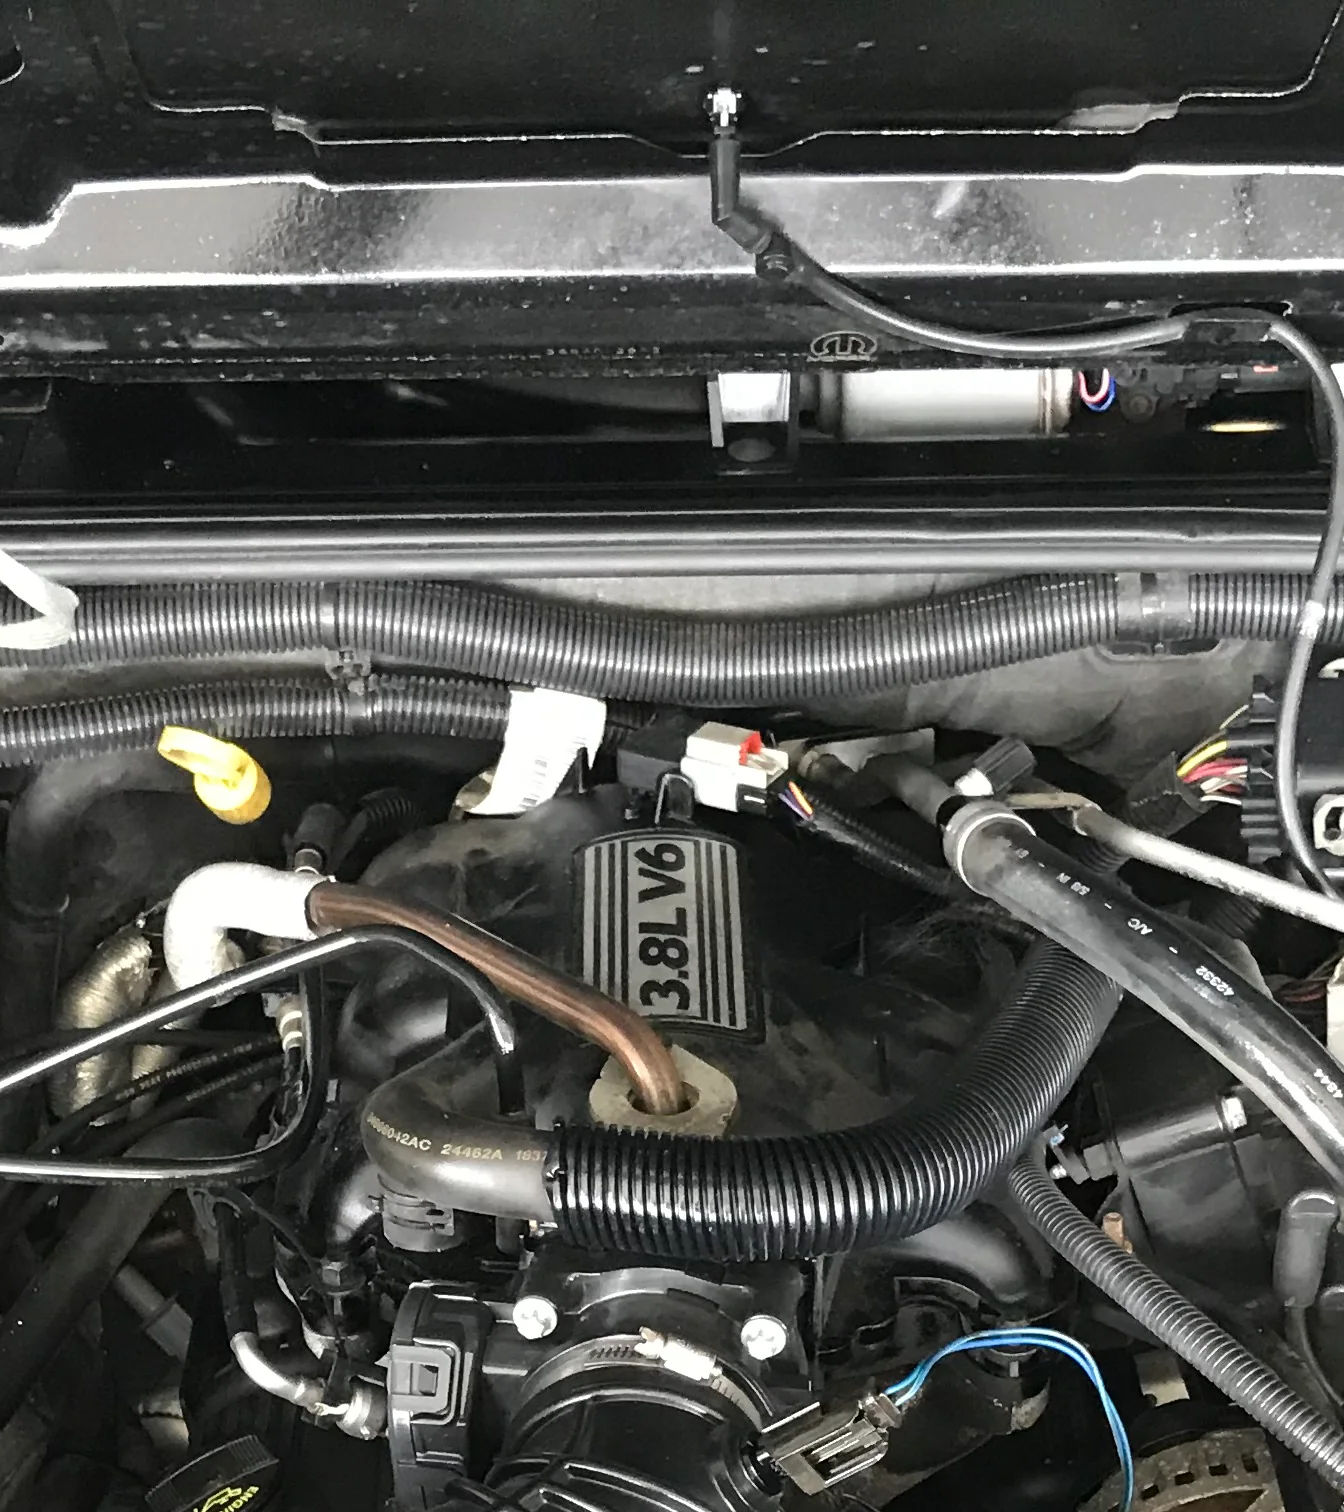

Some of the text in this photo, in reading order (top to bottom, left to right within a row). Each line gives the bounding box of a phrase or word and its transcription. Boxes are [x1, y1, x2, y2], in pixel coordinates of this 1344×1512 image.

[633, 842, 691, 1011] 3.8L V6
[1127, 917, 1153, 936] A/C
[1195, 965, 1235, 997] 42332
